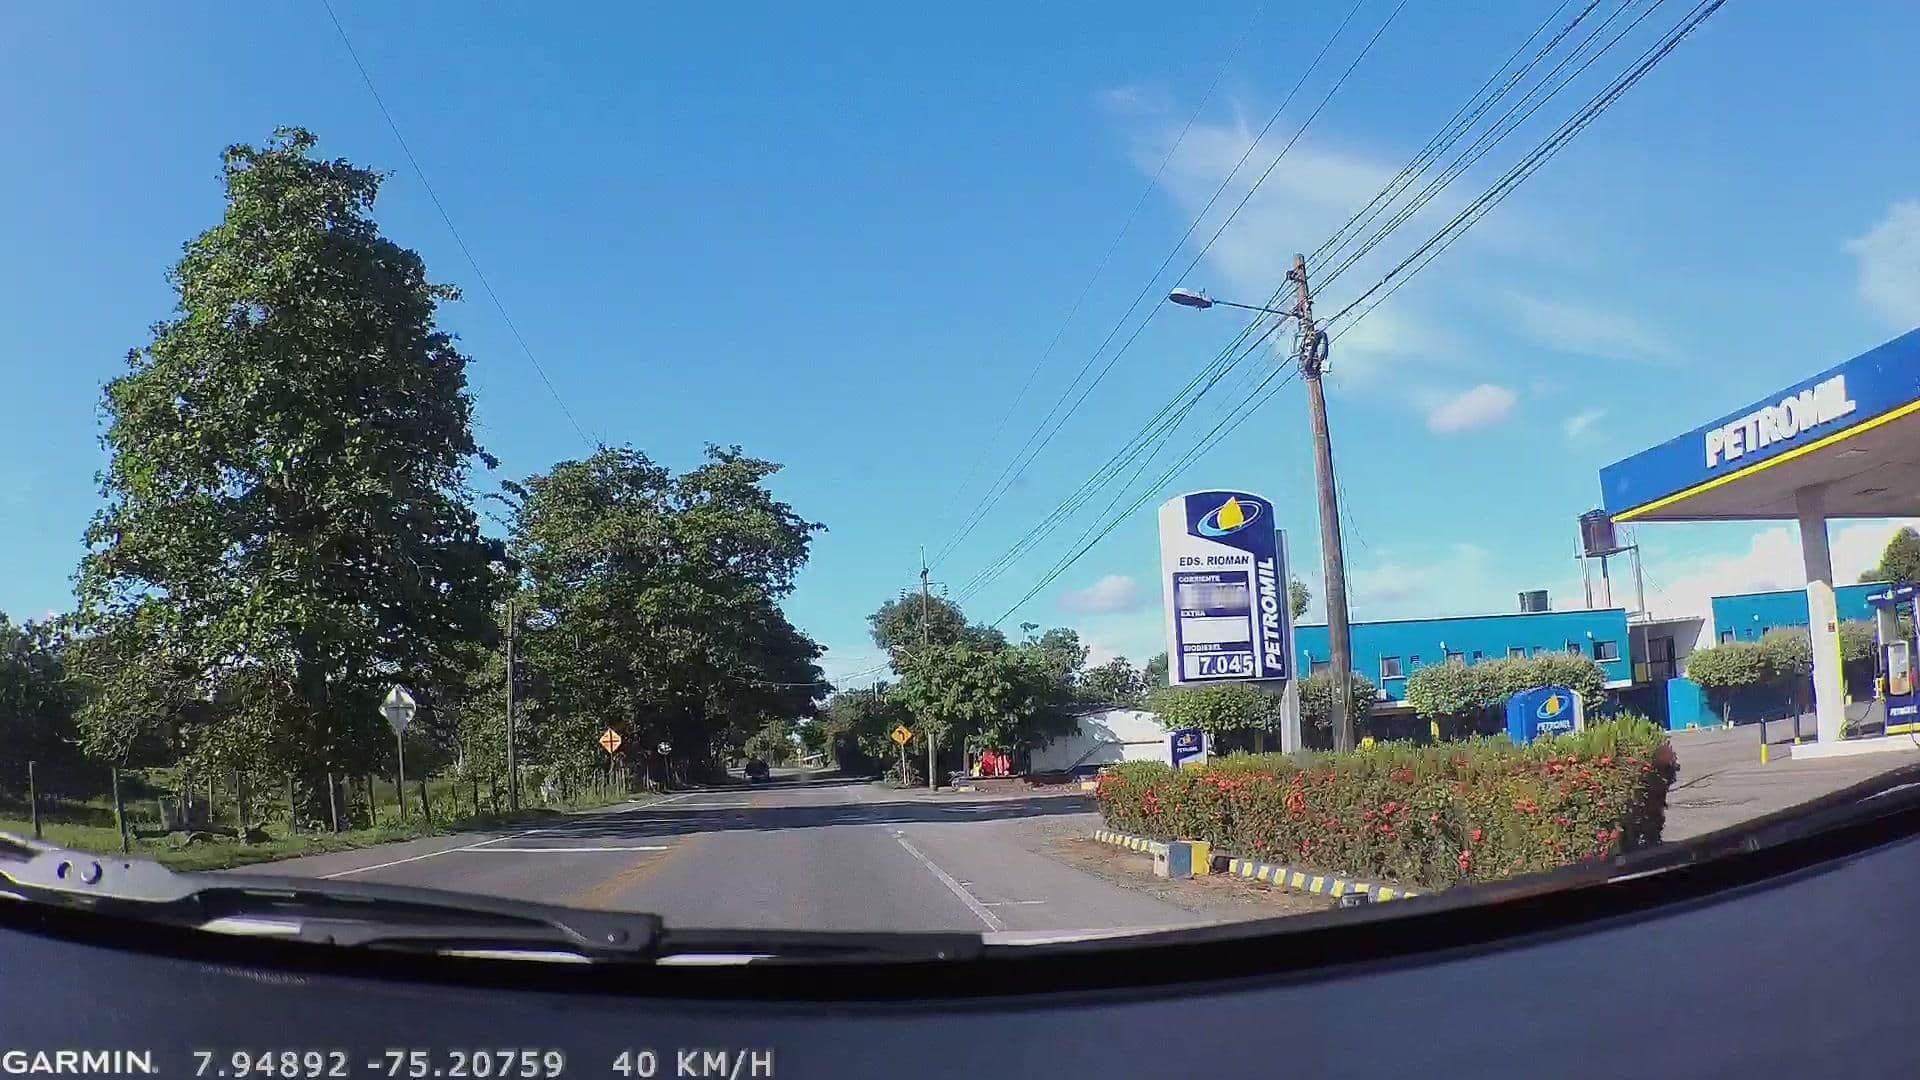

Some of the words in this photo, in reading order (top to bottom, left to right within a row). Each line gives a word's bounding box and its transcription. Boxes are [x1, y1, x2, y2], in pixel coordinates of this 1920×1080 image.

[1705, 374, 1857, 468] PETROMIL
[1179, 556, 1204, 567] EDS.
[1206, 555, 1250, 566] RIOMAN
[1258, 557, 1282, 670] PETROMIL
[1199, 655, 1254, 675] 7.045
